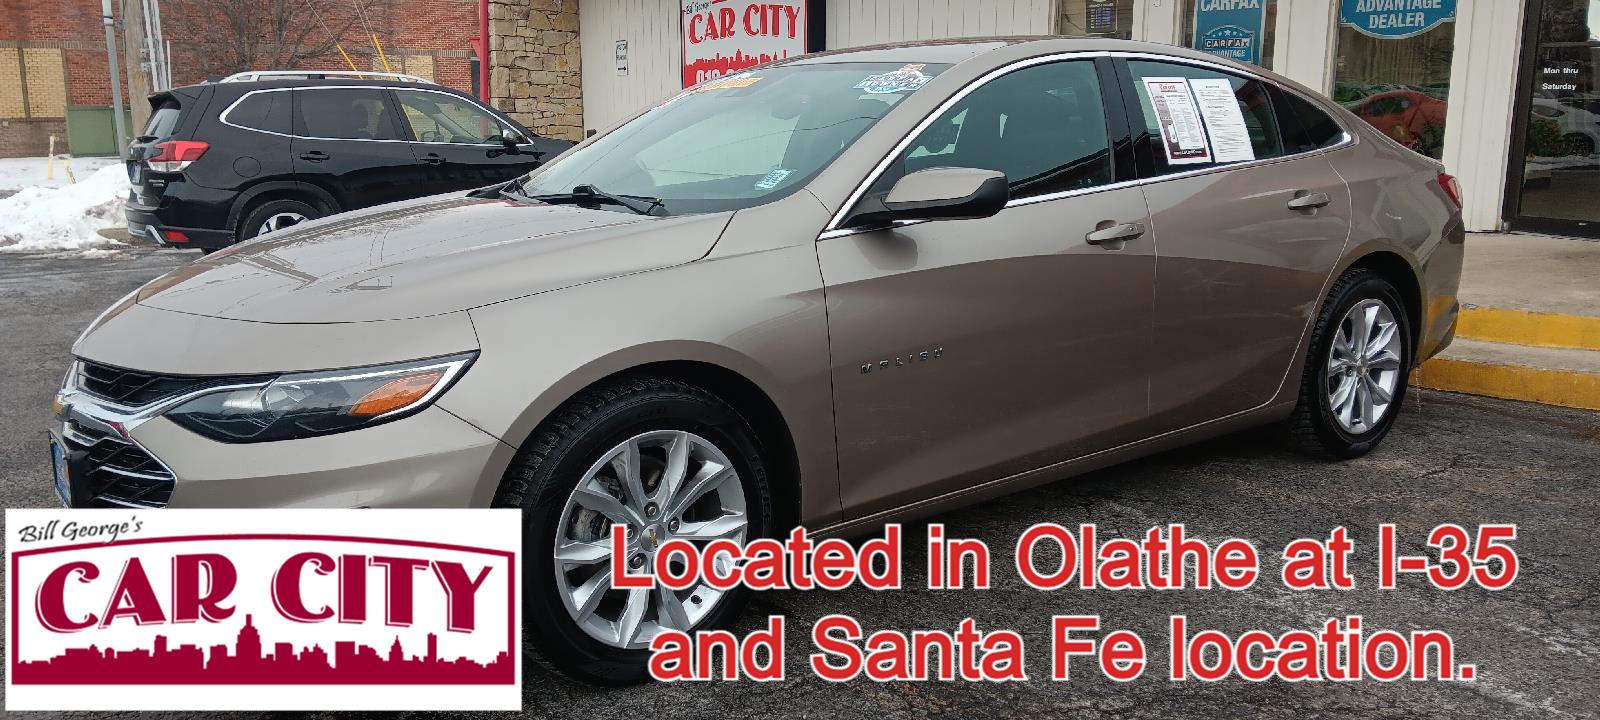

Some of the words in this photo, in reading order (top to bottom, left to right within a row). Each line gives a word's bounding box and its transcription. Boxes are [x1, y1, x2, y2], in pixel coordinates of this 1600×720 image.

[1201, 0, 1259, 11] CARFAX
[1356, 0, 1442, 12] ADVANTAGE
[689, 8, 735, 44] CAR
[743, 4, 800, 39] CITY
[1369, 12, 1425, 29] DEALER
[1206, 39, 1250, 48] CARFAX
[1542, 82, 1577, 91] Saturday
[861, 346, 944, 375] MALIBU
